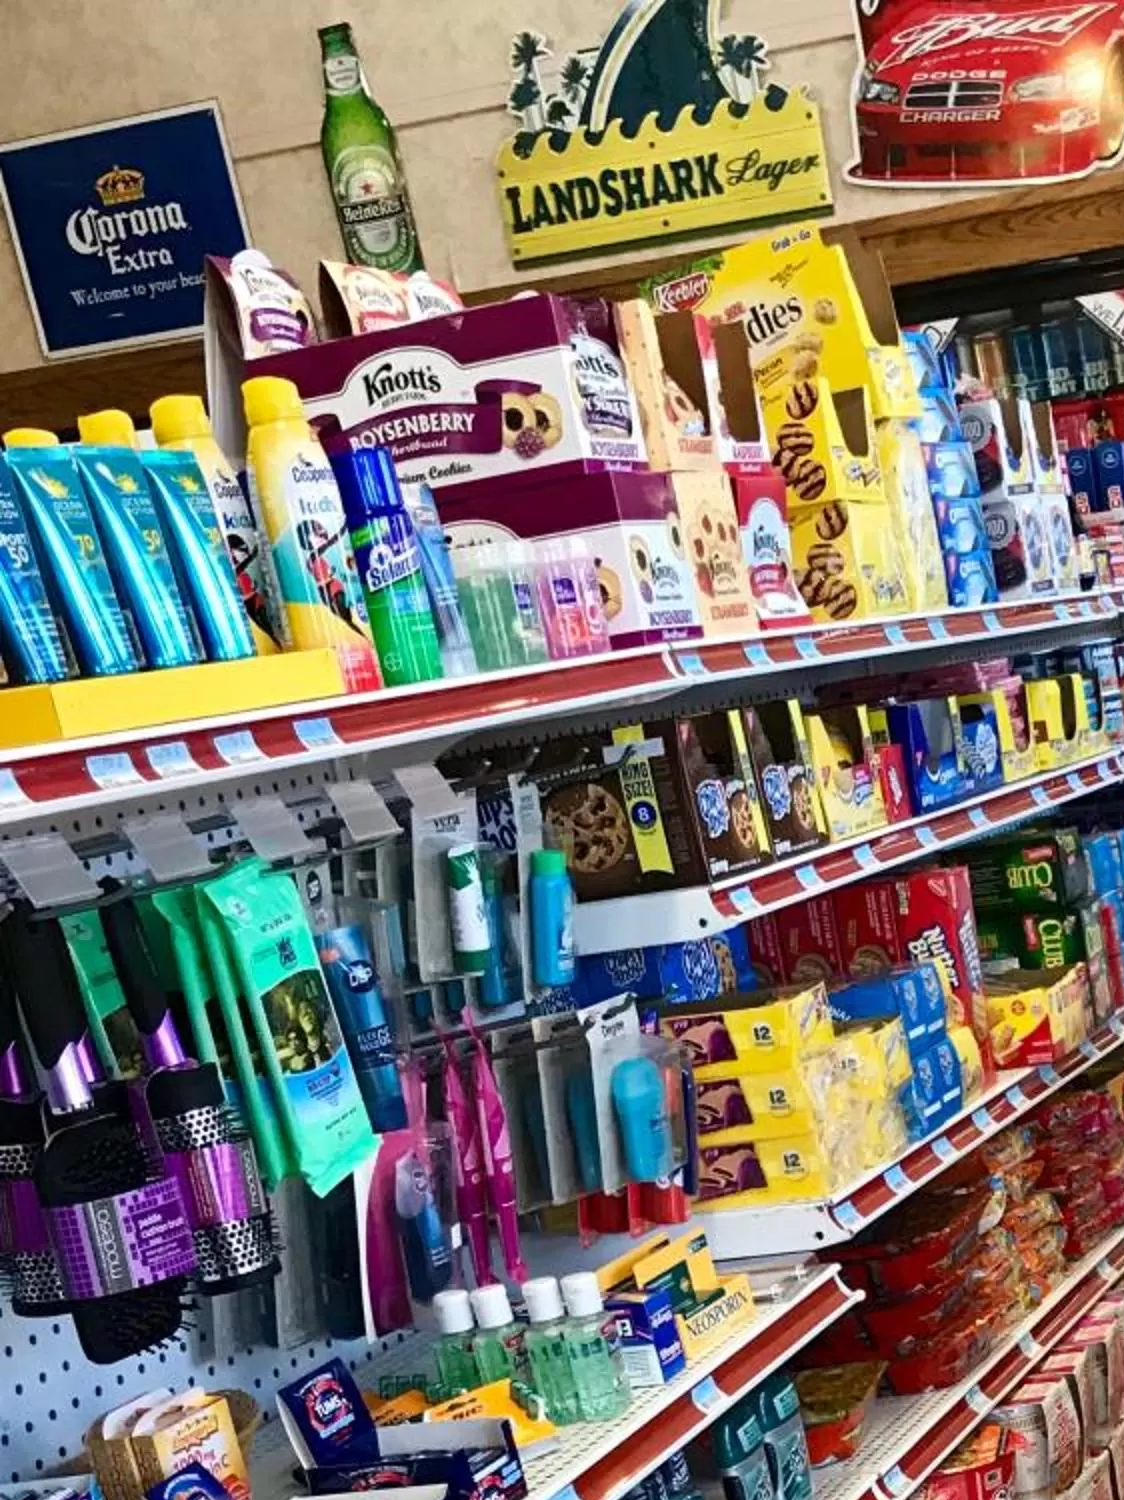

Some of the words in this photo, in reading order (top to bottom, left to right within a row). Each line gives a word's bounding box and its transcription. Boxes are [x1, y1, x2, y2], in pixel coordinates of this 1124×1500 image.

[911, 69, 1008, 80] DODGE
[900, 110, 1001, 123] CHARGER
[505, 152, 725, 234] LANDSHARK
[726, 149, 820, 191] Lager
[66, 202, 188, 256] Corona
[106, 244, 174, 275] Extra
[70, 286, 131, 307] Welcome
[133, 284, 145, 296] to
[150, 279, 177, 299] your
[180, 271, 208, 287] beac
[656, 274, 710, 311] Keebler
[747, 297, 802, 344] dies
[362, 363, 441, 407] Knott's
[350, 412, 475, 452] BOYSENBERRY
[429, 460, 473, 481] Cookies
[637, 807, 649, 822] 8
[1007, 862, 1052, 889] CLUB
[921, 925, 960, 988] Nutter
[1038, 918, 1065, 968] CLUB
[753, 1025, 772, 1041] 12
[768, 1089, 787, 1104] 12
[783, 1153, 801, 1168] 12
[686, 1287, 749, 1338] NEOSPORIN
[315, 1395, 343, 1418] TUMS
